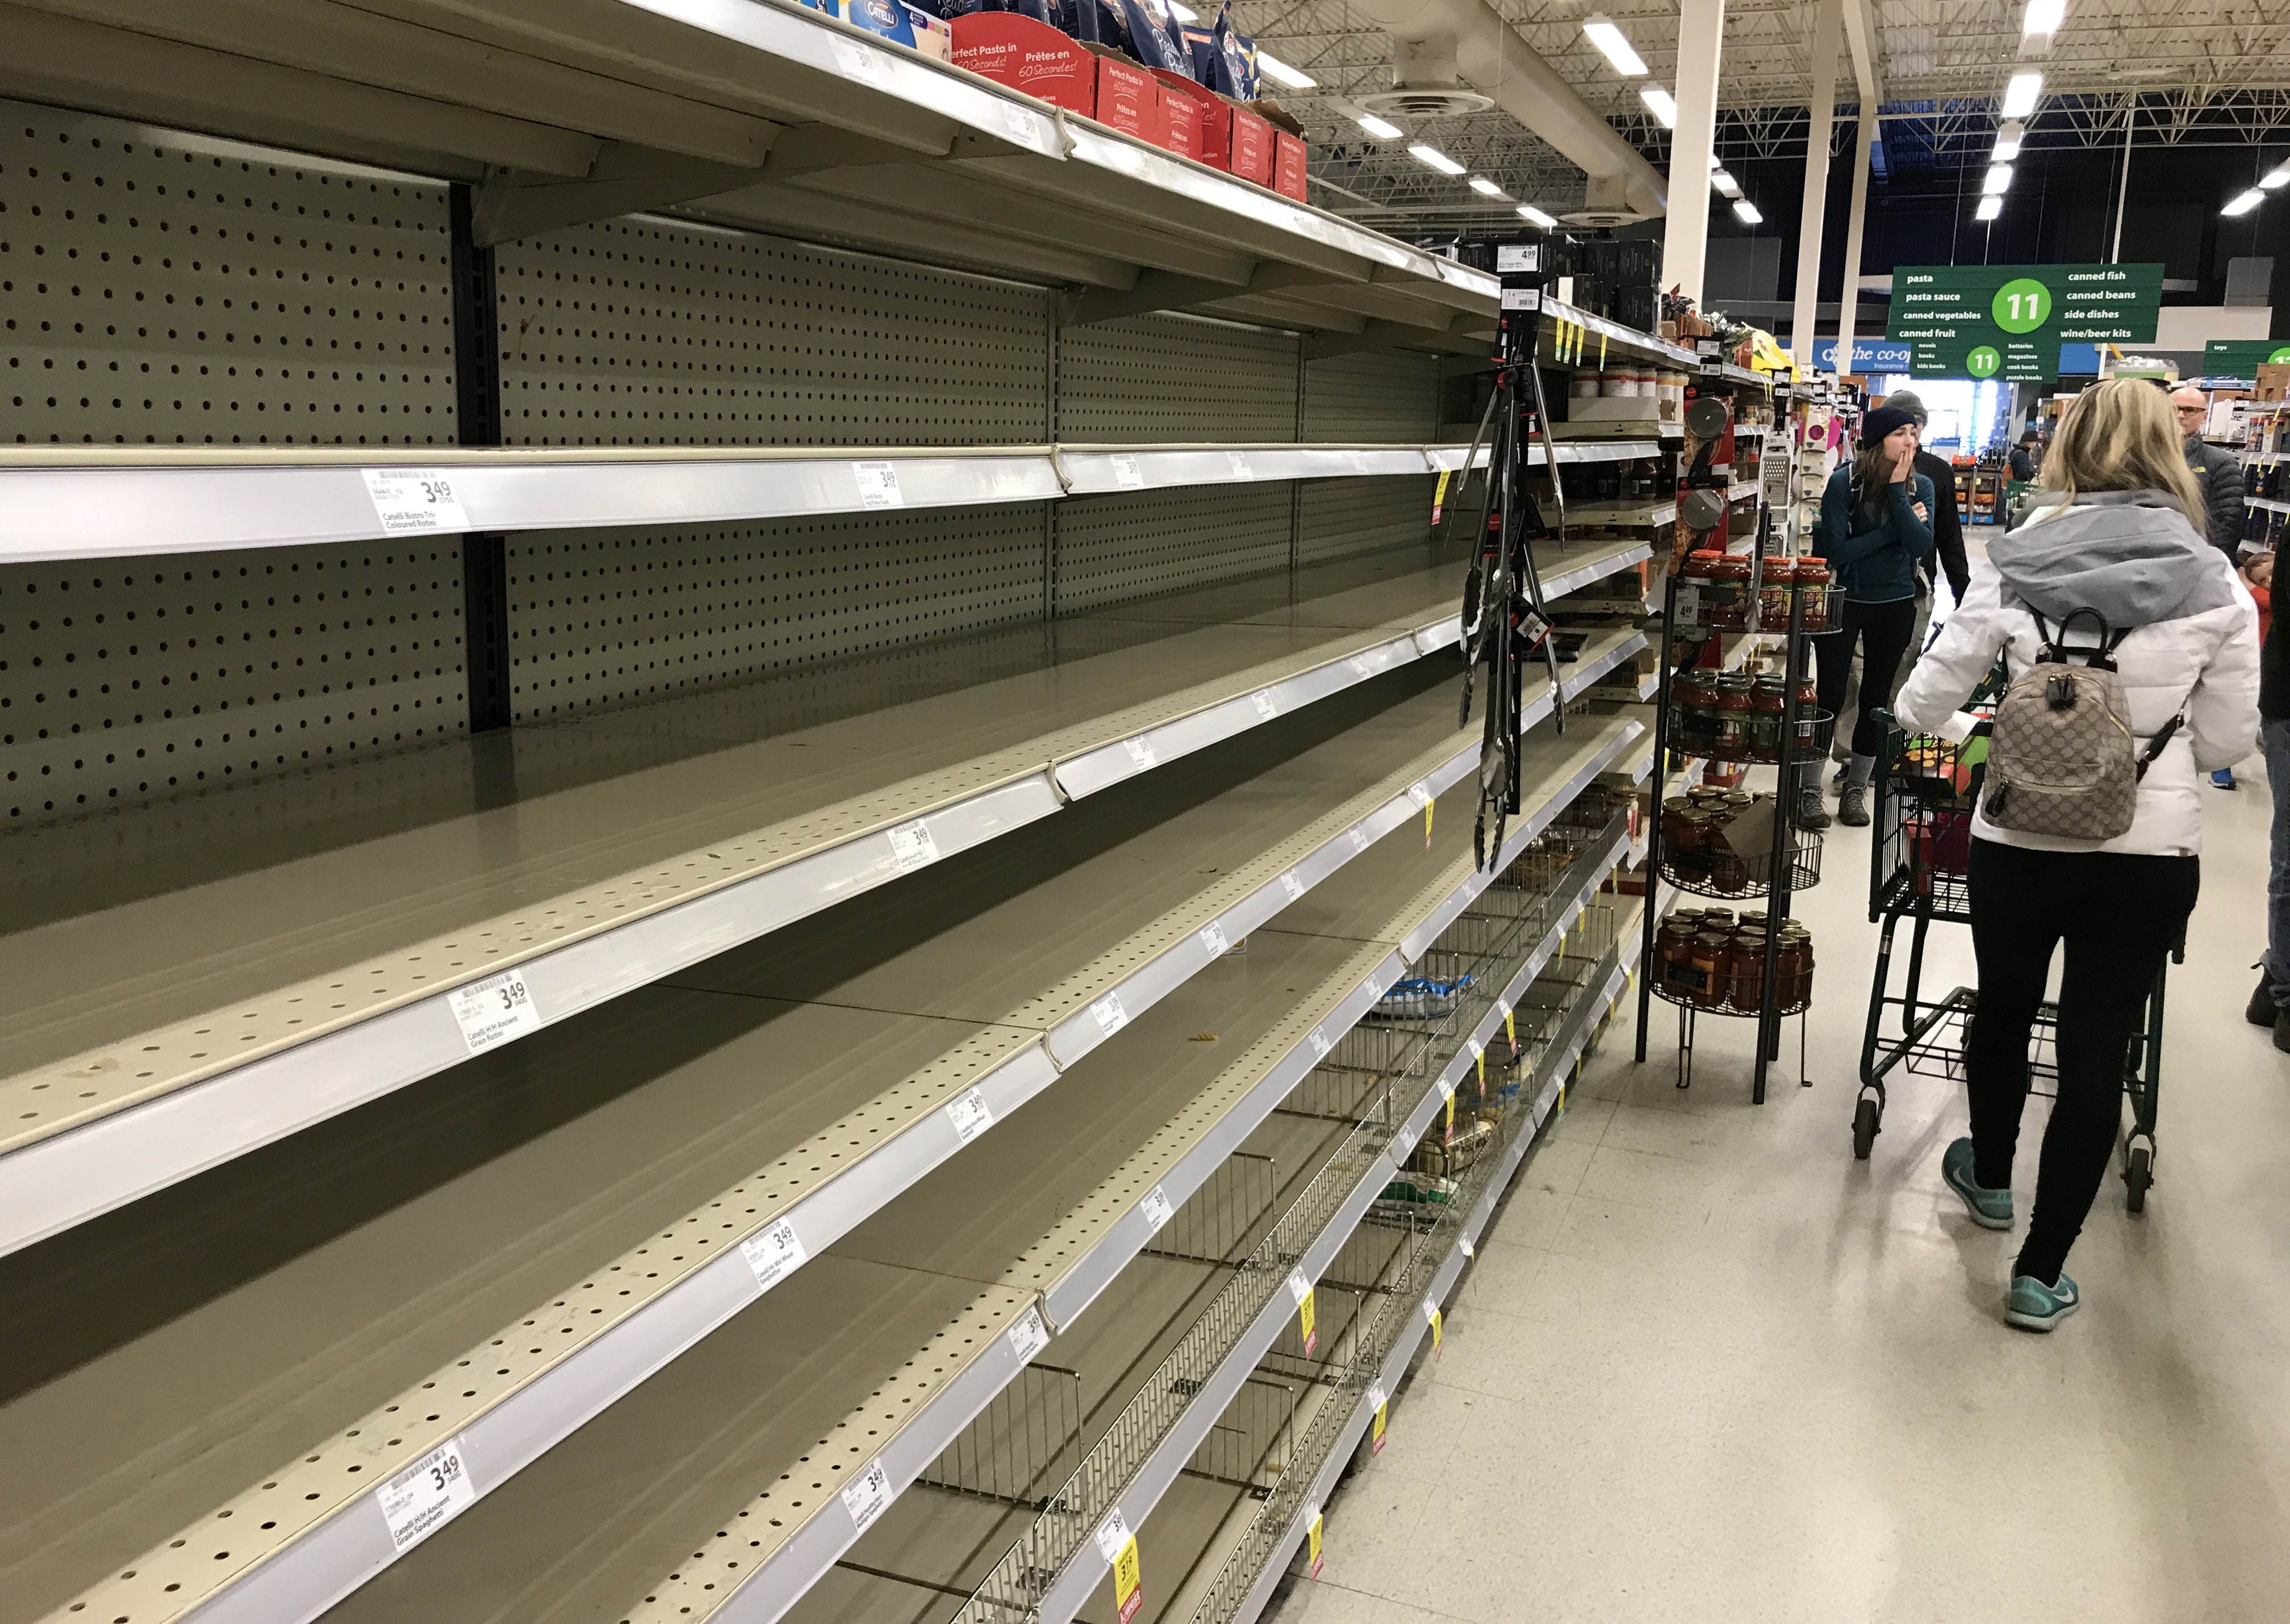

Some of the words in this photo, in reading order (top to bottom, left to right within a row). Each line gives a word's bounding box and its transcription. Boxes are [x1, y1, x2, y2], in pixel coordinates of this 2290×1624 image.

[867, 2, 895, 24] CATELLI
[952, 46, 977, 58] erfect
[979, 44, 1006, 56] Pasta
[1008, 43, 1017, 52] in
[1026, 51, 1055, 62] Prêtes
[1058, 50, 1069, 59] en
[1907, 275, 1933, 284] pasta
[2068, 271, 2105, 281] canned
[2107, 271, 2126, 280] fish
[1906, 294, 1932, 303] pasta
[2067, 290, 2104, 300] canned
[2105, 290, 2136, 299] beans
[2007, 294, 2040, 320] 11
[2065, 309, 2085, 319] side
[2087, 309, 2120, 319] dishes
[1935, 311, 1981, 321] vegetables
[1899, 329, 1933, 337] canned
[1935, 329, 1955, 337] fruit
[2060, 329, 2111, 337] wine/beer
[2112, 329, 2132, 337] kits
[1852, 346, 1873, 360] the
[1975, 354, 1993, 369] 11
[880, 471, 895, 487] 349
[420, 482, 451, 503] 349
[913, 828, 927, 845] 349
[500, 982, 525, 1010] 349
[498, 1015, 519, 1029] Ancient
[773, 1226, 792, 1249] 349
[431, 1455, 458, 1491] 349
[868, 1468, 883, 1492] 349
[394, 1520, 414, 1538] Catelli
[427, 1495, 450, 1516] Ancient
[396, 1530, 415, 1546] Grain
